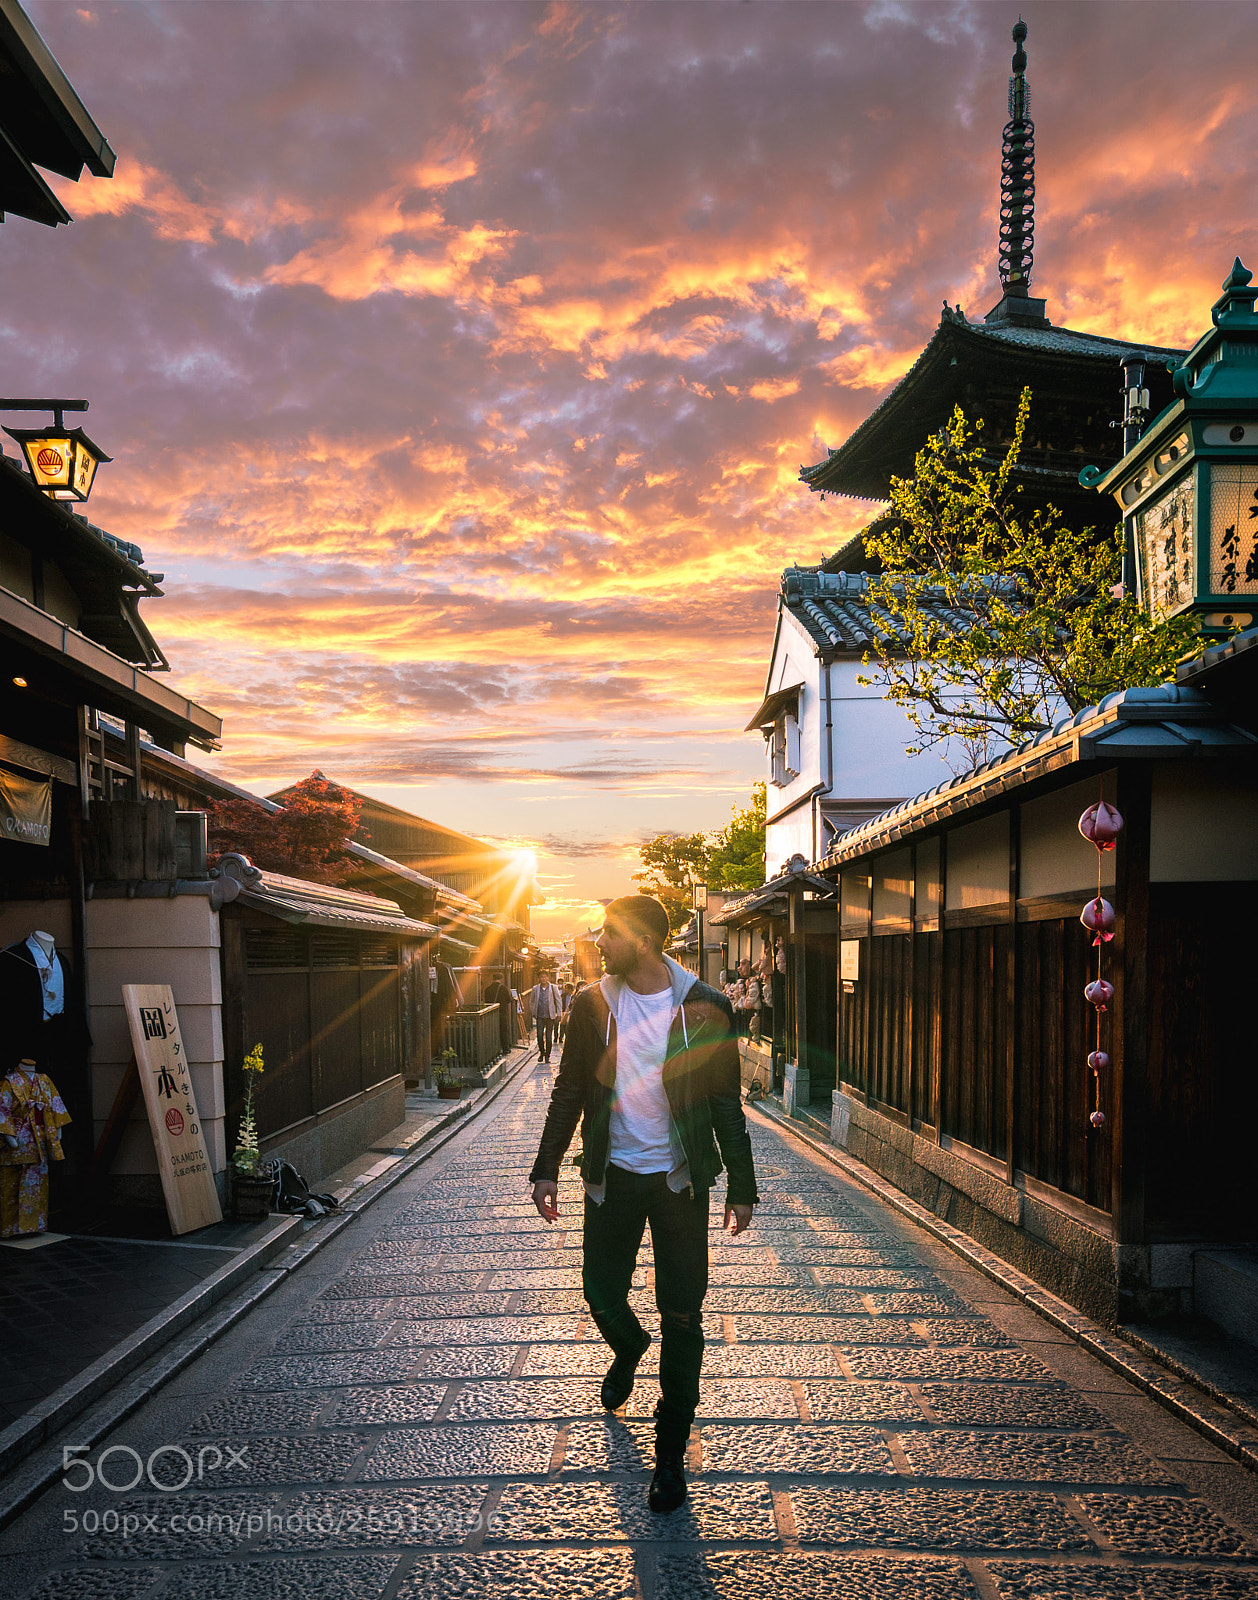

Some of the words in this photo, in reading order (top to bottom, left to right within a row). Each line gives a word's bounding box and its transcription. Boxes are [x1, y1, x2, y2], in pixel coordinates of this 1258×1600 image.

[6, 817, 49, 839] OKAMOTO
[139, 1007, 180, 1099] 岡本
[163, 1002, 199, 1135] レンタルきもの
[171, 1149, 204, 1166] OKAMOTO
